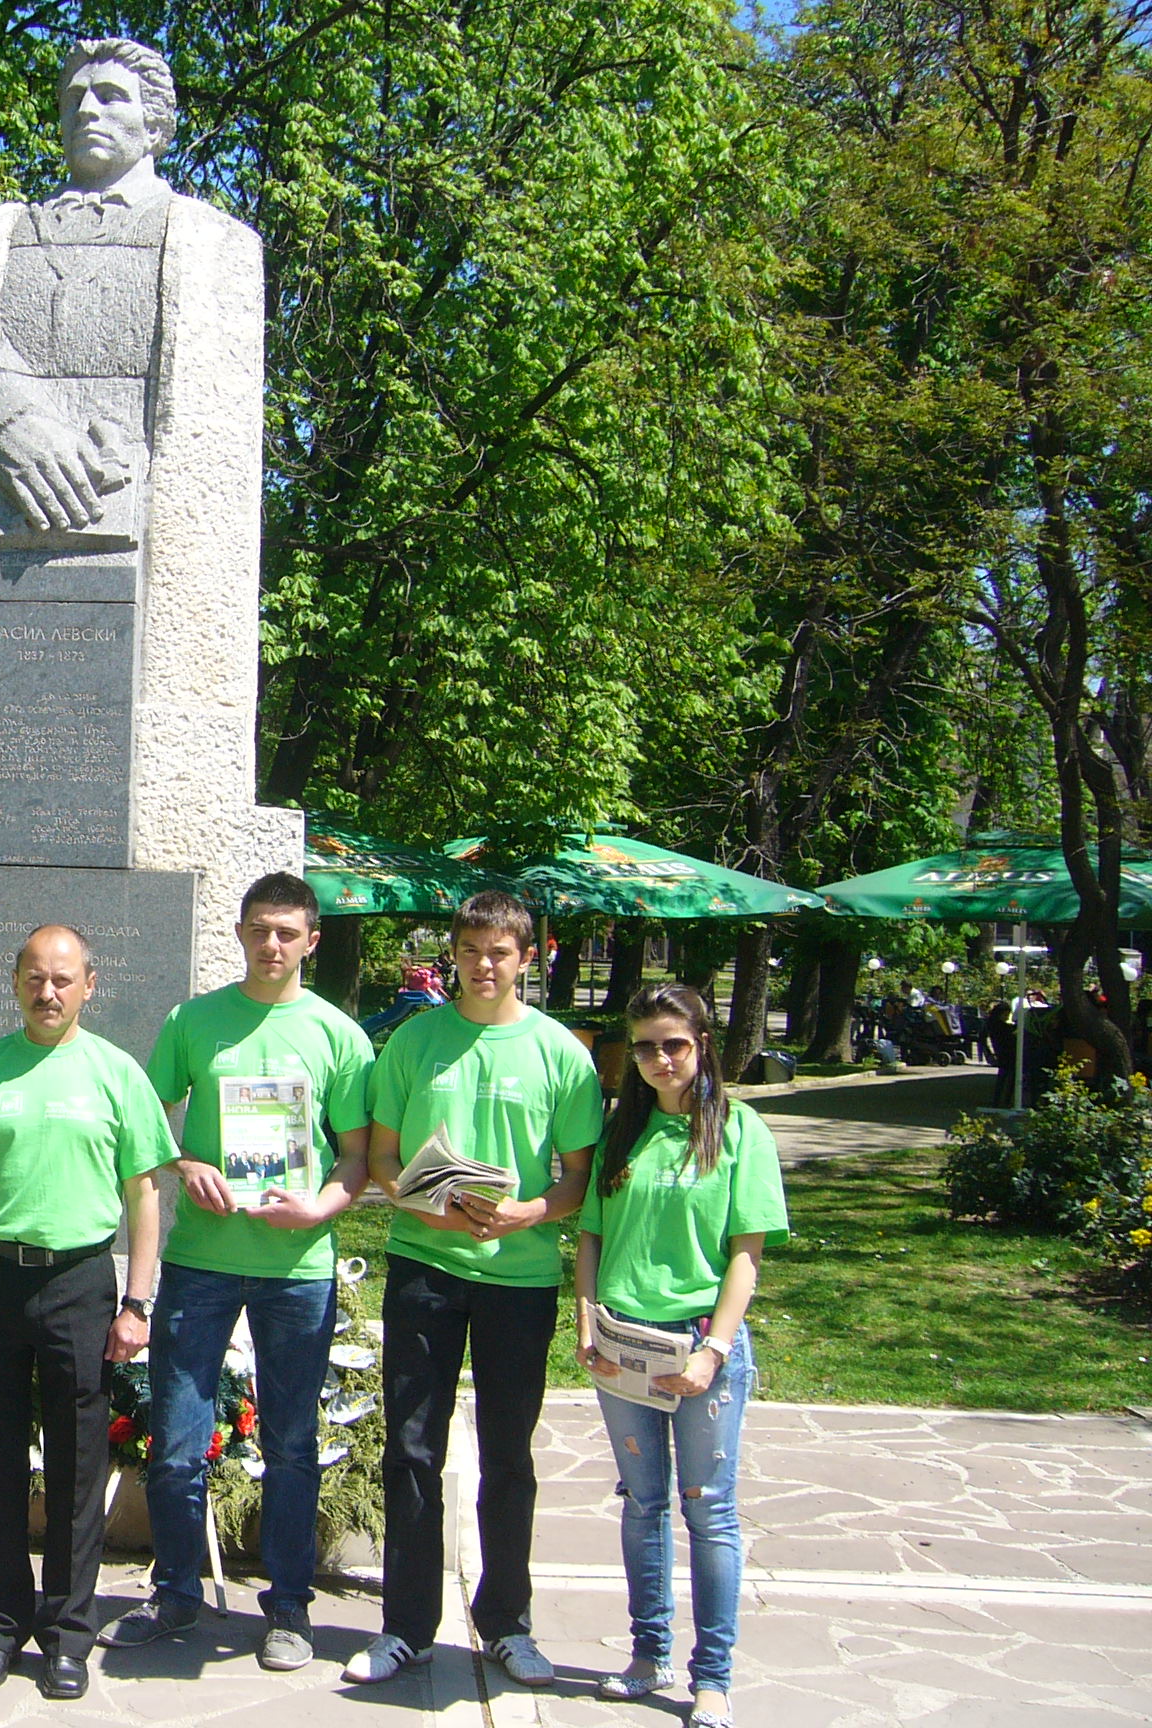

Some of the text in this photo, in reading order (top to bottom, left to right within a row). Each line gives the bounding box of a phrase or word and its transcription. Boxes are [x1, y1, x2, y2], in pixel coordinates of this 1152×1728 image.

[51, 627, 117, 641] ЛЕВСКИ
[69, 924, 142, 938] ОБОДАТА
[89, 954, 129, 968] ОЙНА
[81, 1003, 103, 1015] ЛО
[225, 1103, 258, 1114] НОВА
